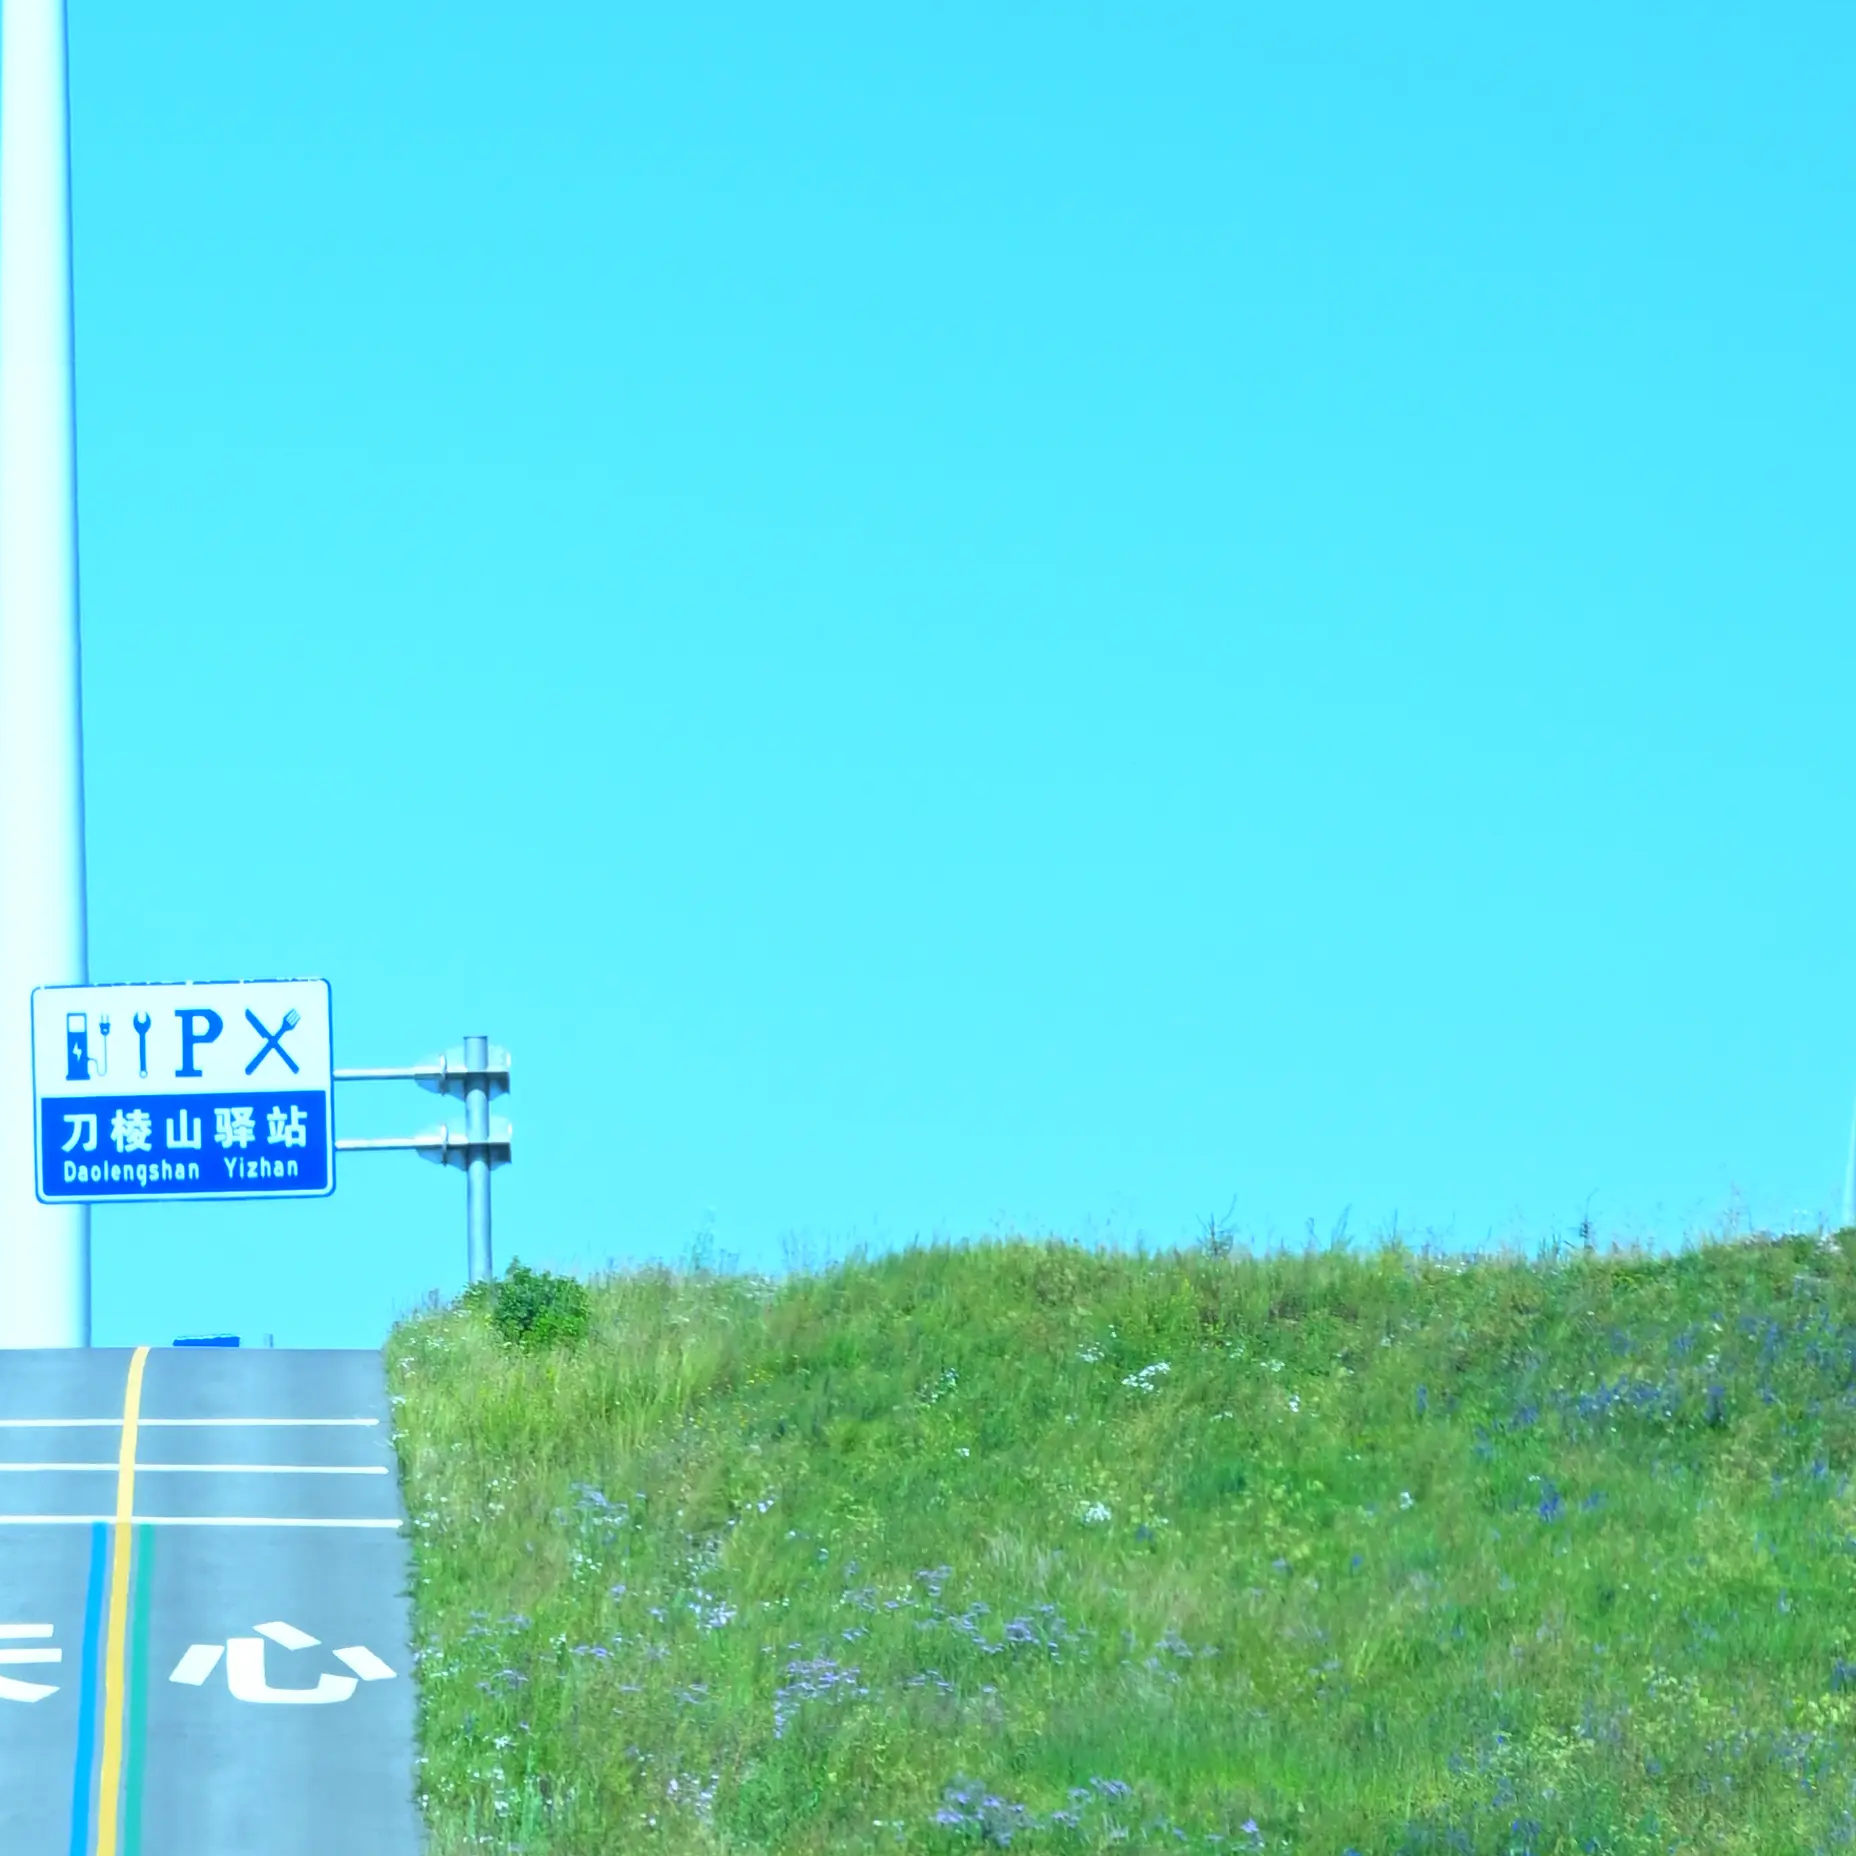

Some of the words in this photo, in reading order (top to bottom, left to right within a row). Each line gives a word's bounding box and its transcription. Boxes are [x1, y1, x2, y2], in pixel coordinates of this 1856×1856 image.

[174, 1008, 224, 1078] P
[61, 1105, 308, 1153] 刀棱山驿站
[63, 1159, 200, 1186] Daolengshan
[223, 1156, 299, 1179] Yizhan
